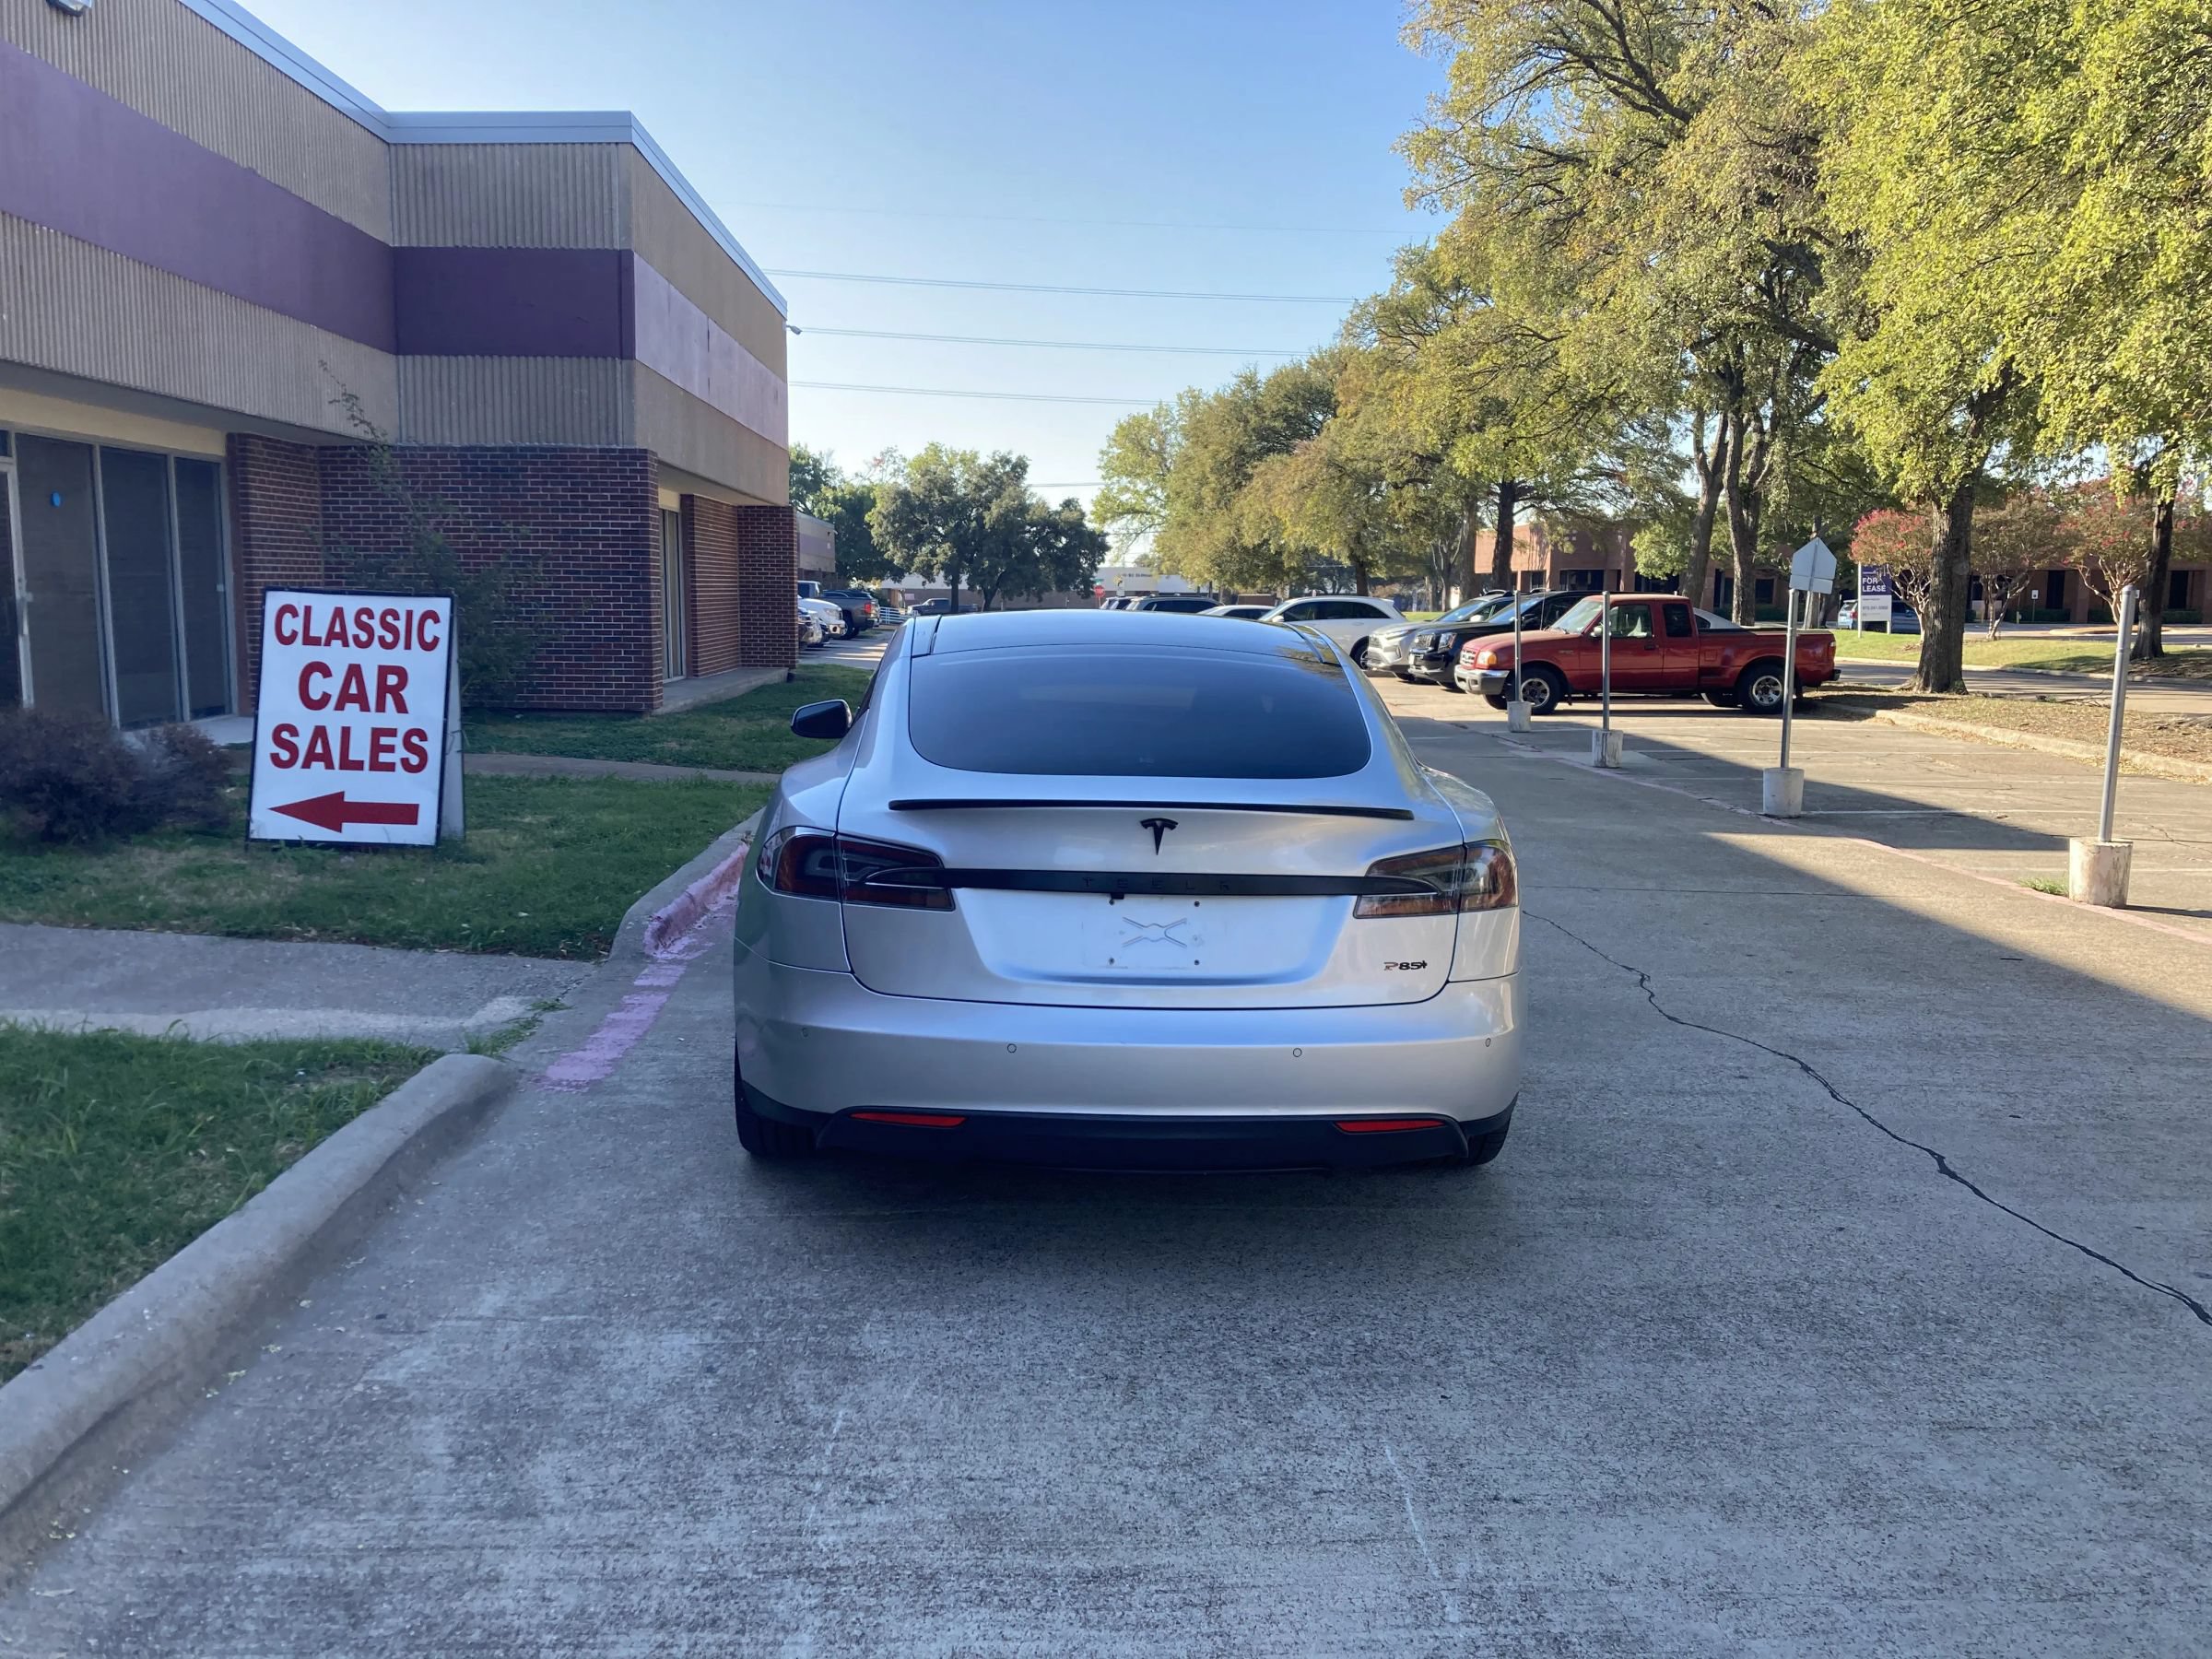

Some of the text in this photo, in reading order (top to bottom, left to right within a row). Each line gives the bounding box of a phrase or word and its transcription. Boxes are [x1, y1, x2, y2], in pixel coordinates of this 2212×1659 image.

[1862, 577, 1878, 585] FOR
[274, 604, 441, 652] CLASSIC
[298, 661, 409, 714] CAR
[269, 723, 429, 774] SALES
